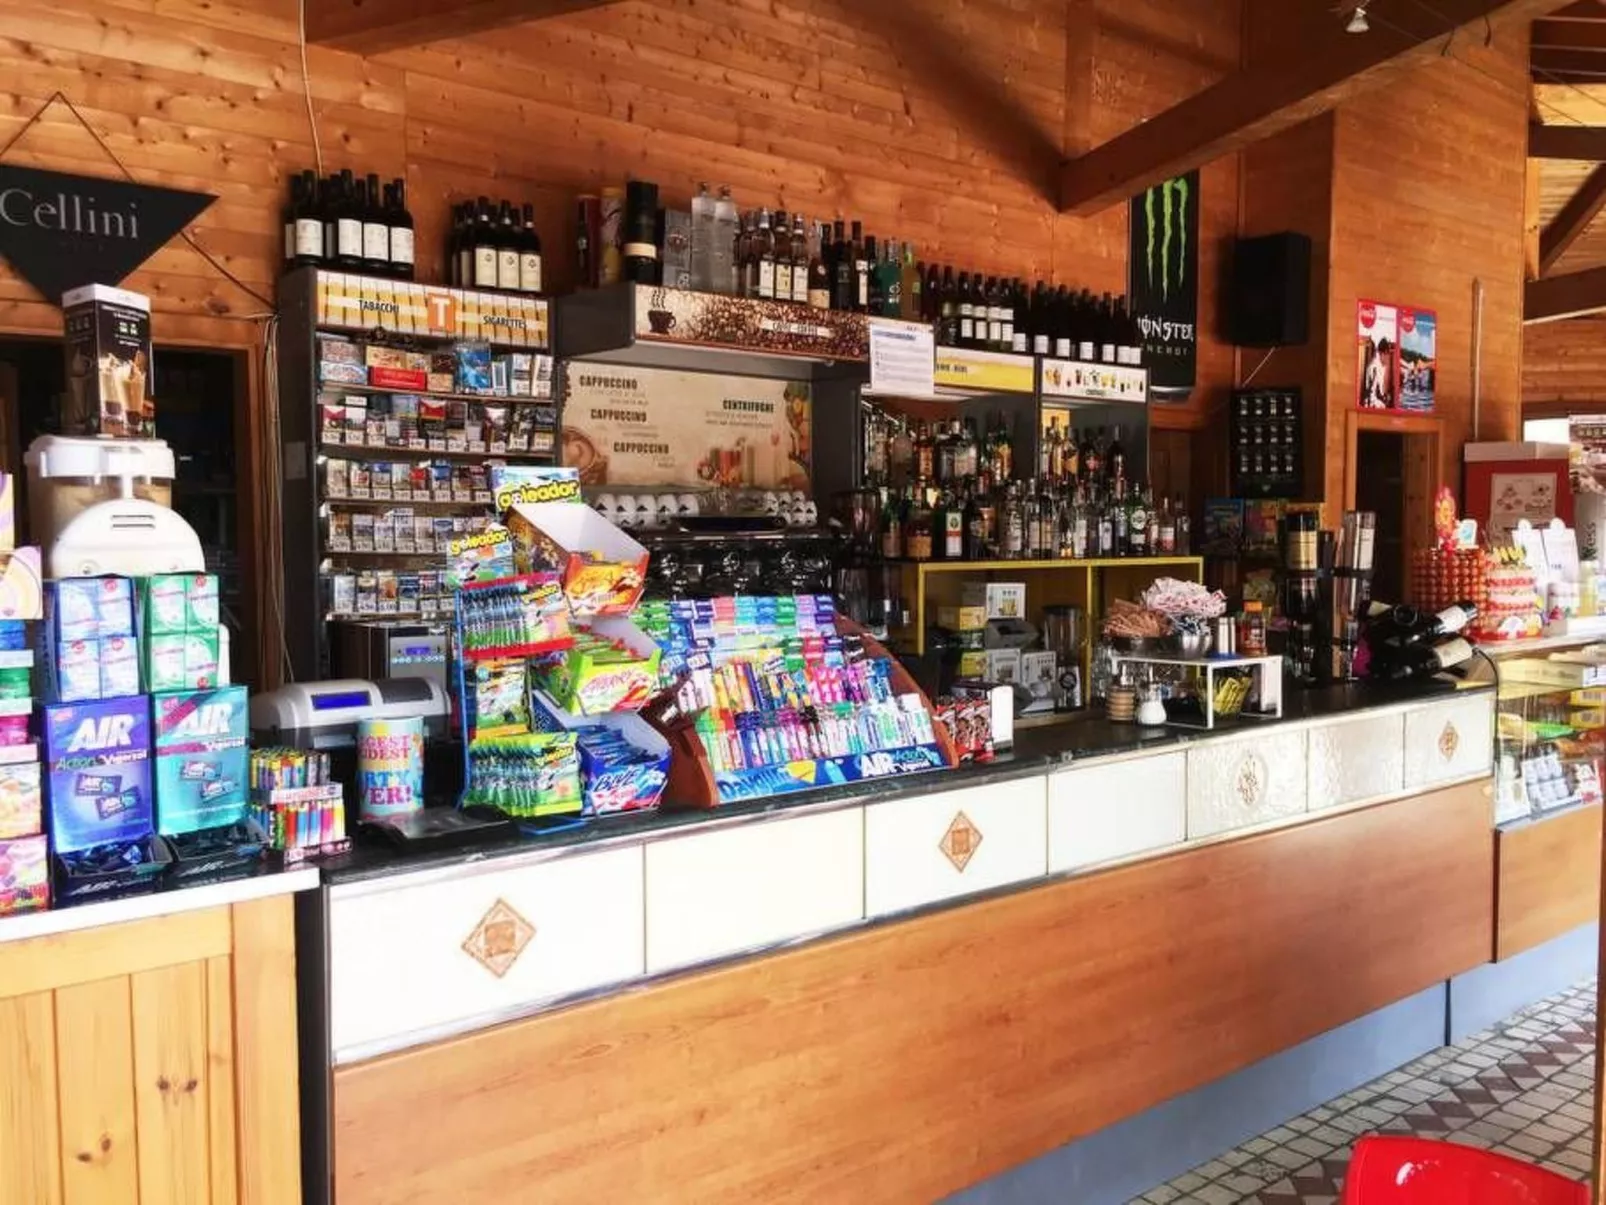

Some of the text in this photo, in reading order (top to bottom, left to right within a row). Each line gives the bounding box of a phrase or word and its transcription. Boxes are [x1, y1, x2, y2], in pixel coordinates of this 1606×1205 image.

[0, 188, 139, 239] Cellini
[358, 299, 400, 314] TABACCHI
[431, 294, 451, 327] T
[579, 375, 638, 390] CAPPUCCINO
[590, 408, 648, 423] CAPPUCCINO
[613, 441, 670, 455] CAPPUCCINO
[450, 528, 510, 557] goleador
[67, 713, 135, 753] AIR
[860, 752, 894, 779] AIR
